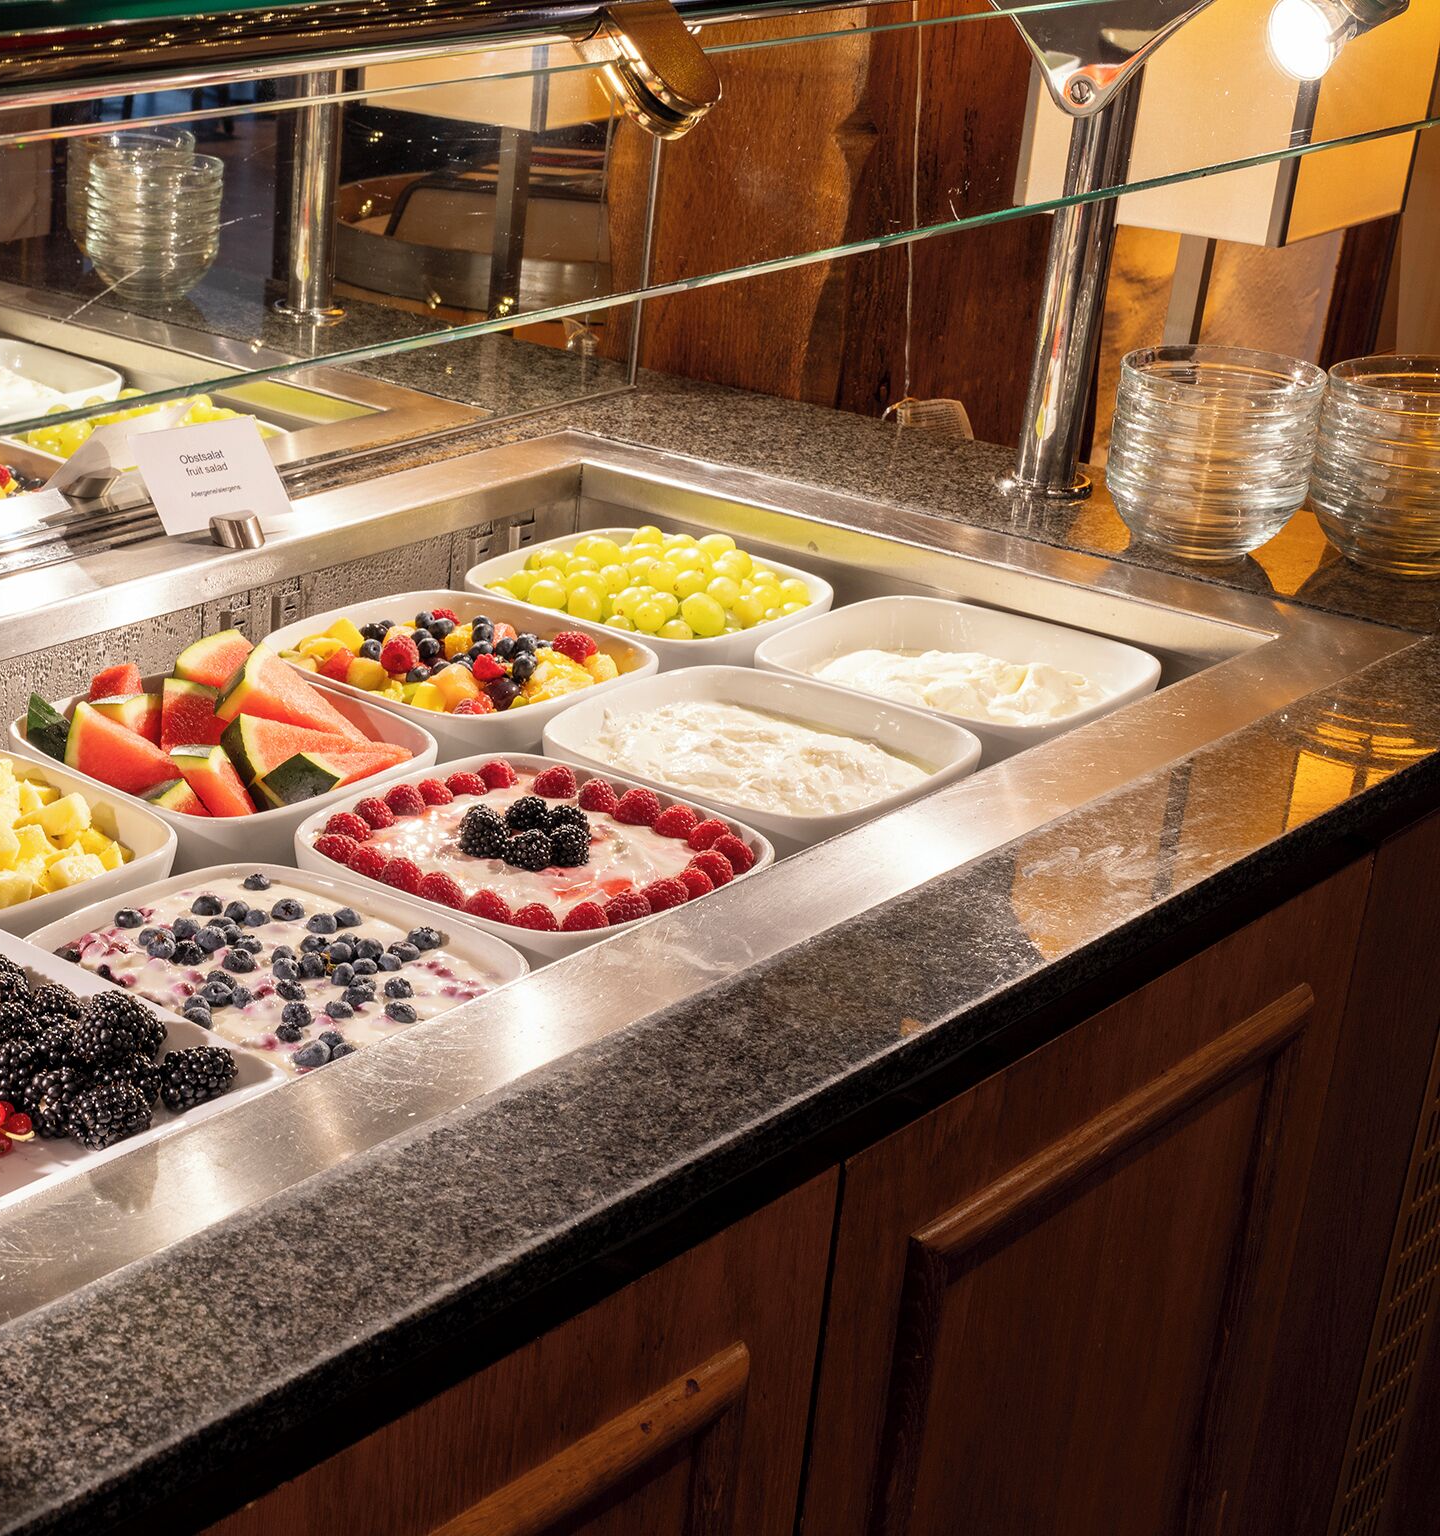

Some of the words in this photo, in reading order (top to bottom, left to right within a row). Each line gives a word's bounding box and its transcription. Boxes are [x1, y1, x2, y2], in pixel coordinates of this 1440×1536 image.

[179, 449, 225, 464] Obstsalat
[185, 466, 204, 477] fruit
[204, 462, 229, 474] salad
